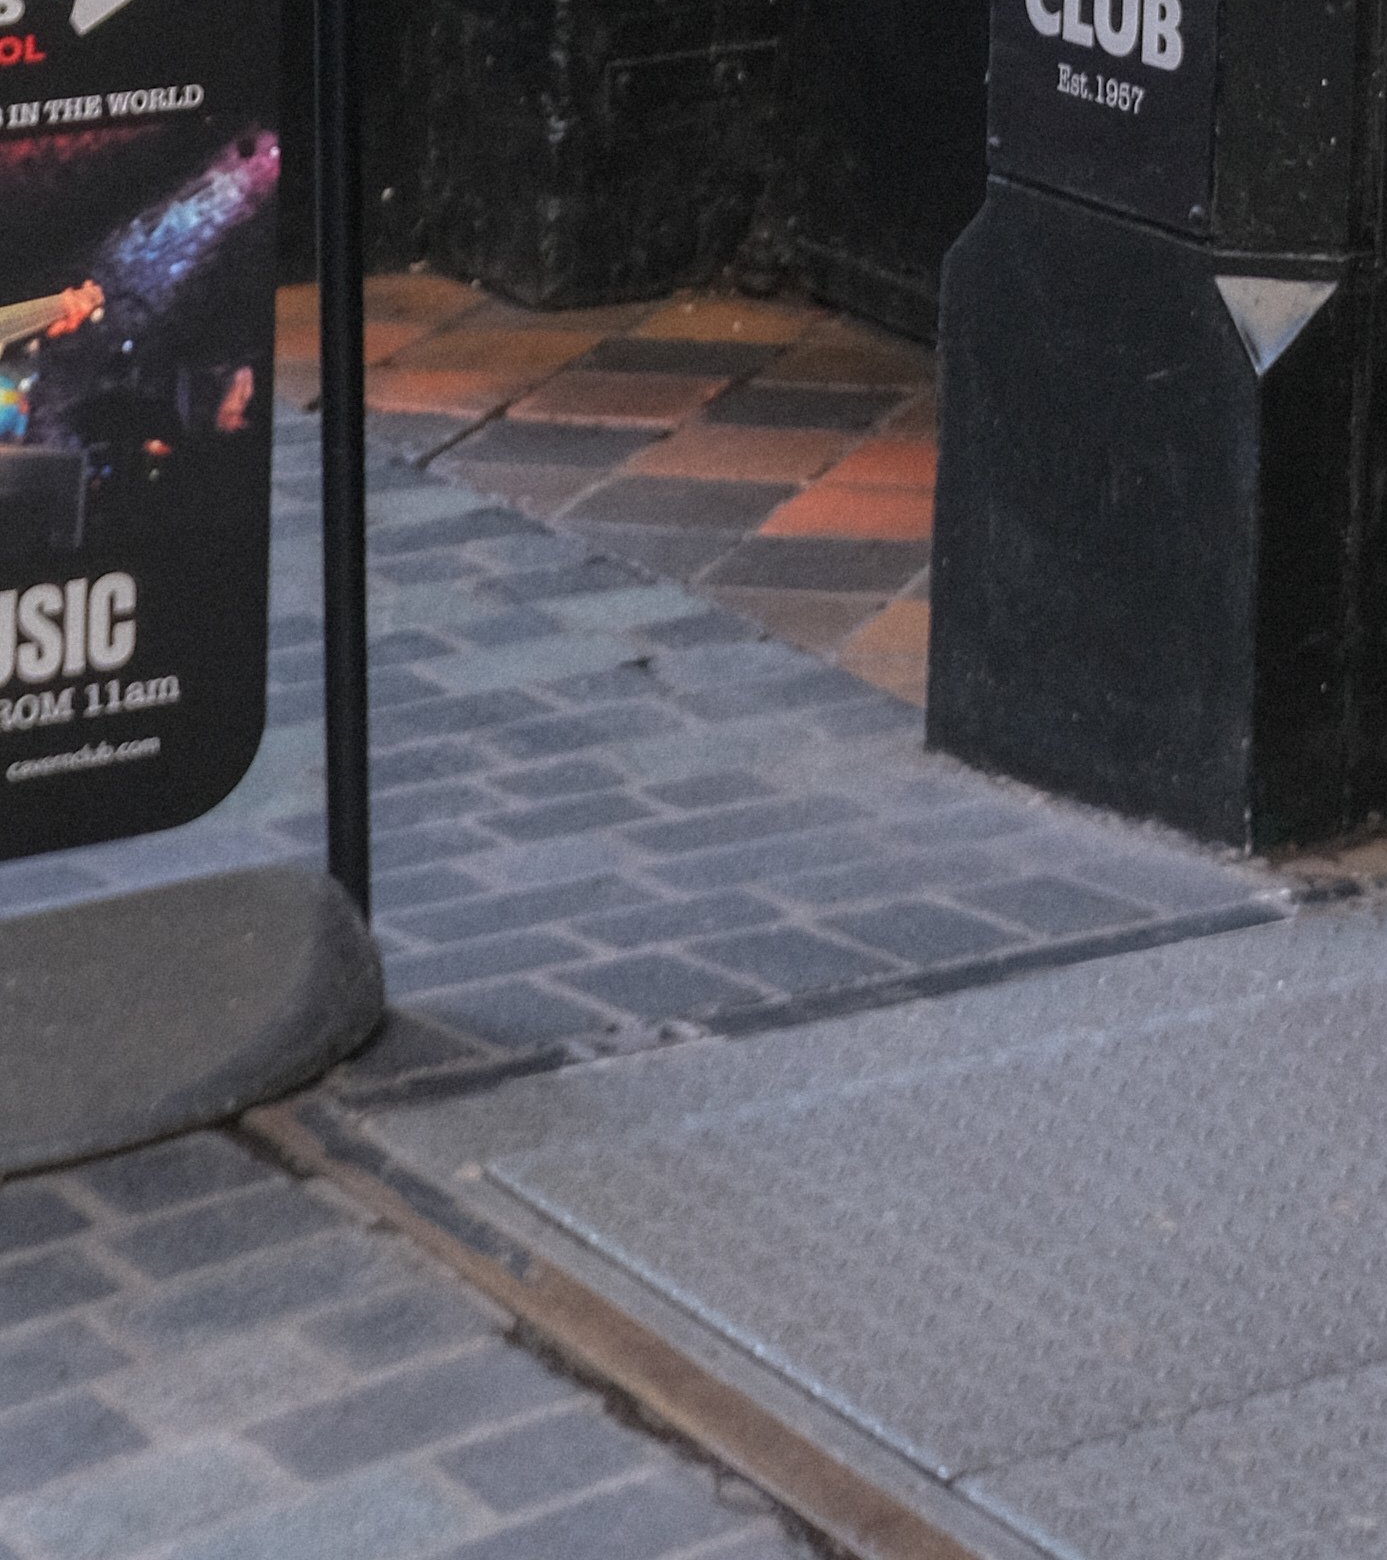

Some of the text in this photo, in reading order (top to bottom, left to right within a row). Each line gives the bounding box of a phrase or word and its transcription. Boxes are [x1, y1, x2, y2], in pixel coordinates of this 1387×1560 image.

[6, 83, 205, 130] IN THE WORLD
[1056, 62, 1145, 114] Est.1957
[83, 674, 181, 718] 11am
